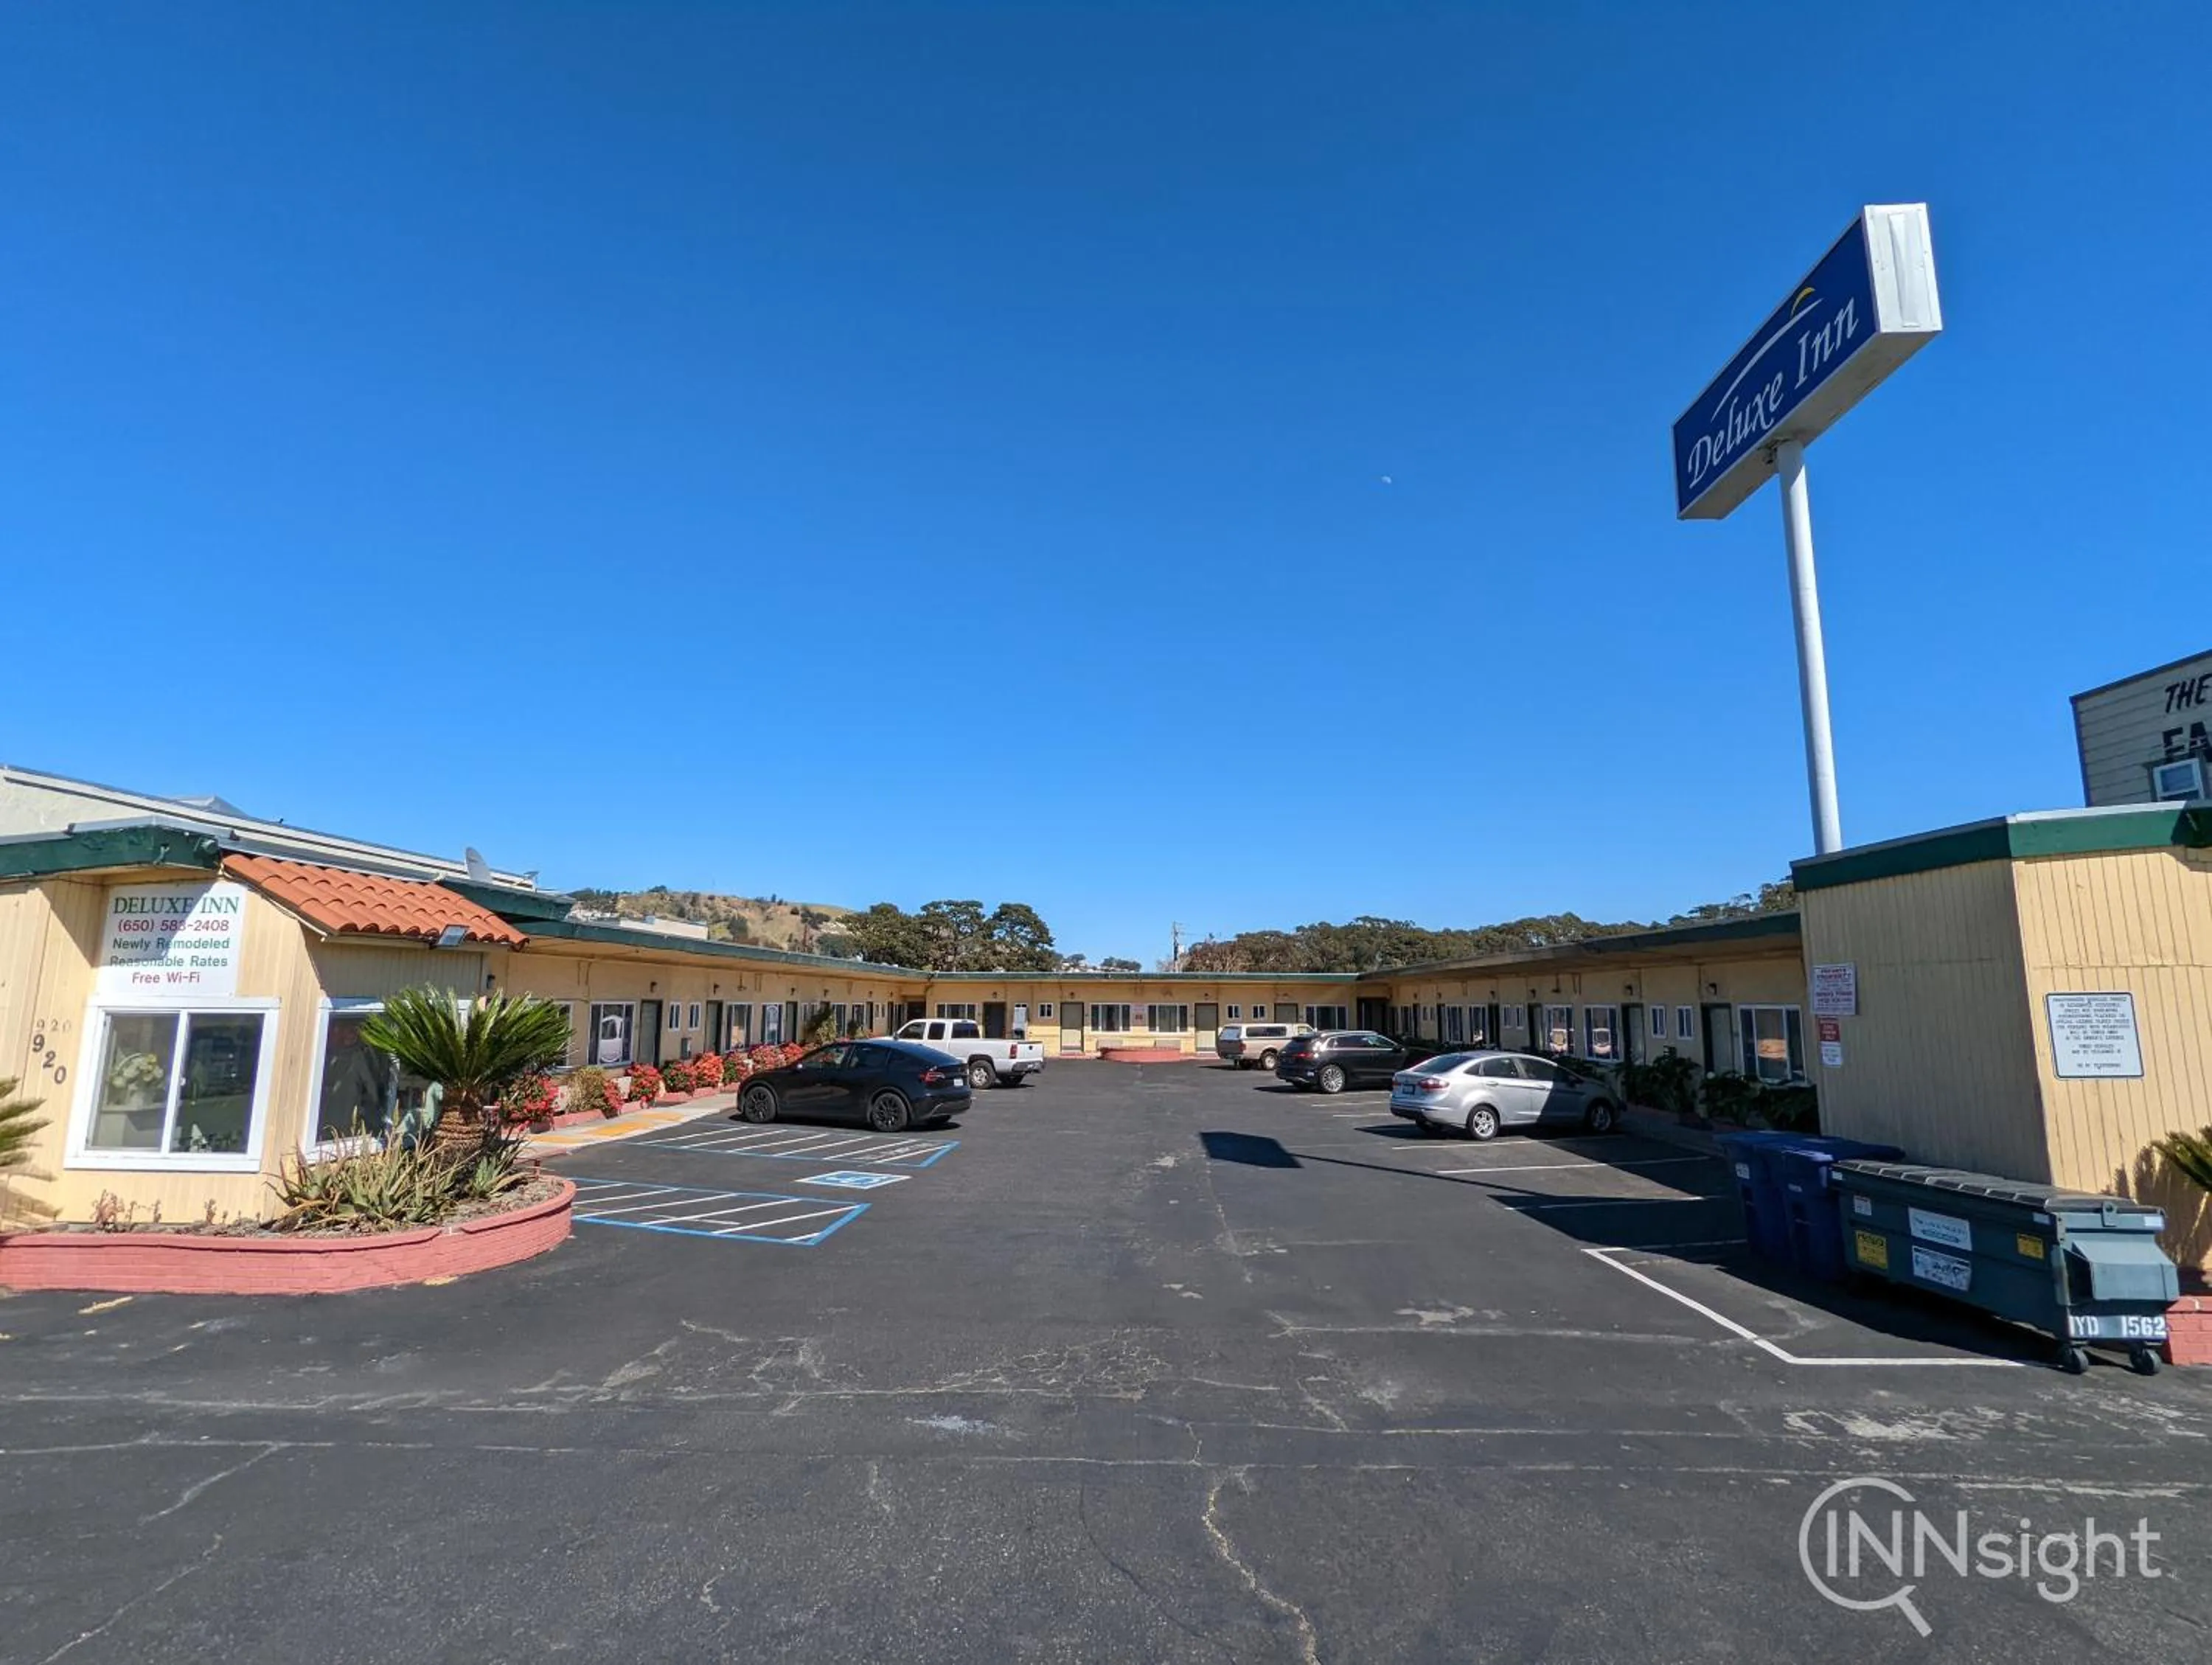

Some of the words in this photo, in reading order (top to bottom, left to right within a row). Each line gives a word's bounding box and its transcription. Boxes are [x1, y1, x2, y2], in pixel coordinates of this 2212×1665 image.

[1687, 371, 1784, 489] Deluxe
[1794, 296, 1860, 389] Inn
[2165, 673, 2212, 714] THE
[114, 897, 193, 914] DELUXE
[200, 896, 240, 914] INN
[118, 919, 154, 932] (650)
[160, 919, 229, 931] 583-2408
[112, 937, 151, 951] Newly
[156, 937, 231, 949] Remodeled
[110, 955, 184, 967] Reasonable
[190, 955, 228, 967] Rates
[132, 972, 160, 984] Free
[166, 971, 201, 983] Wi-Fi
[2121, 1315, 2167, 1337] 1562
